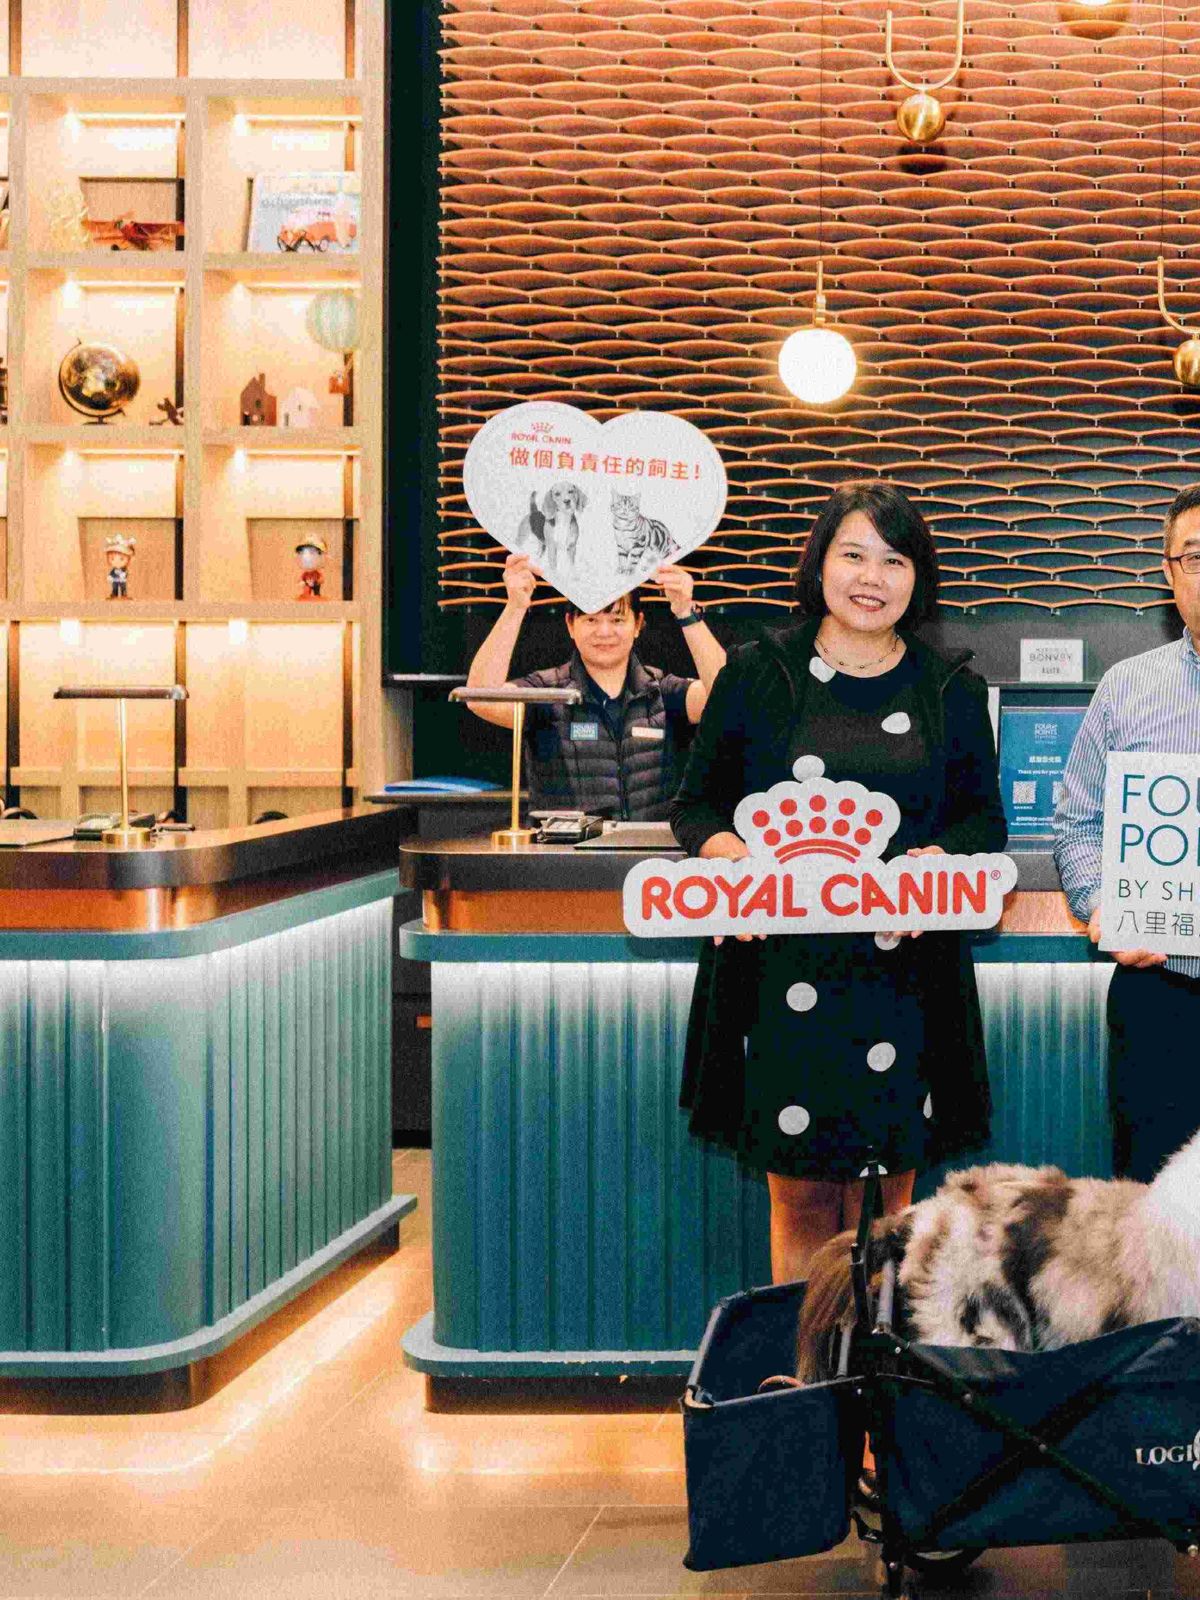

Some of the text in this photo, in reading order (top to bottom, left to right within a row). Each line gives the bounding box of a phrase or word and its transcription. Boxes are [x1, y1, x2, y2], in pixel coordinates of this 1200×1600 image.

[510, 432, 572, 445] ROYAL CANIN
[509, 447, 700, 480] 做個負責任的飼主!
[641, 872, 808, 921] ROYAL
[1117, 878, 1149, 899] BY
